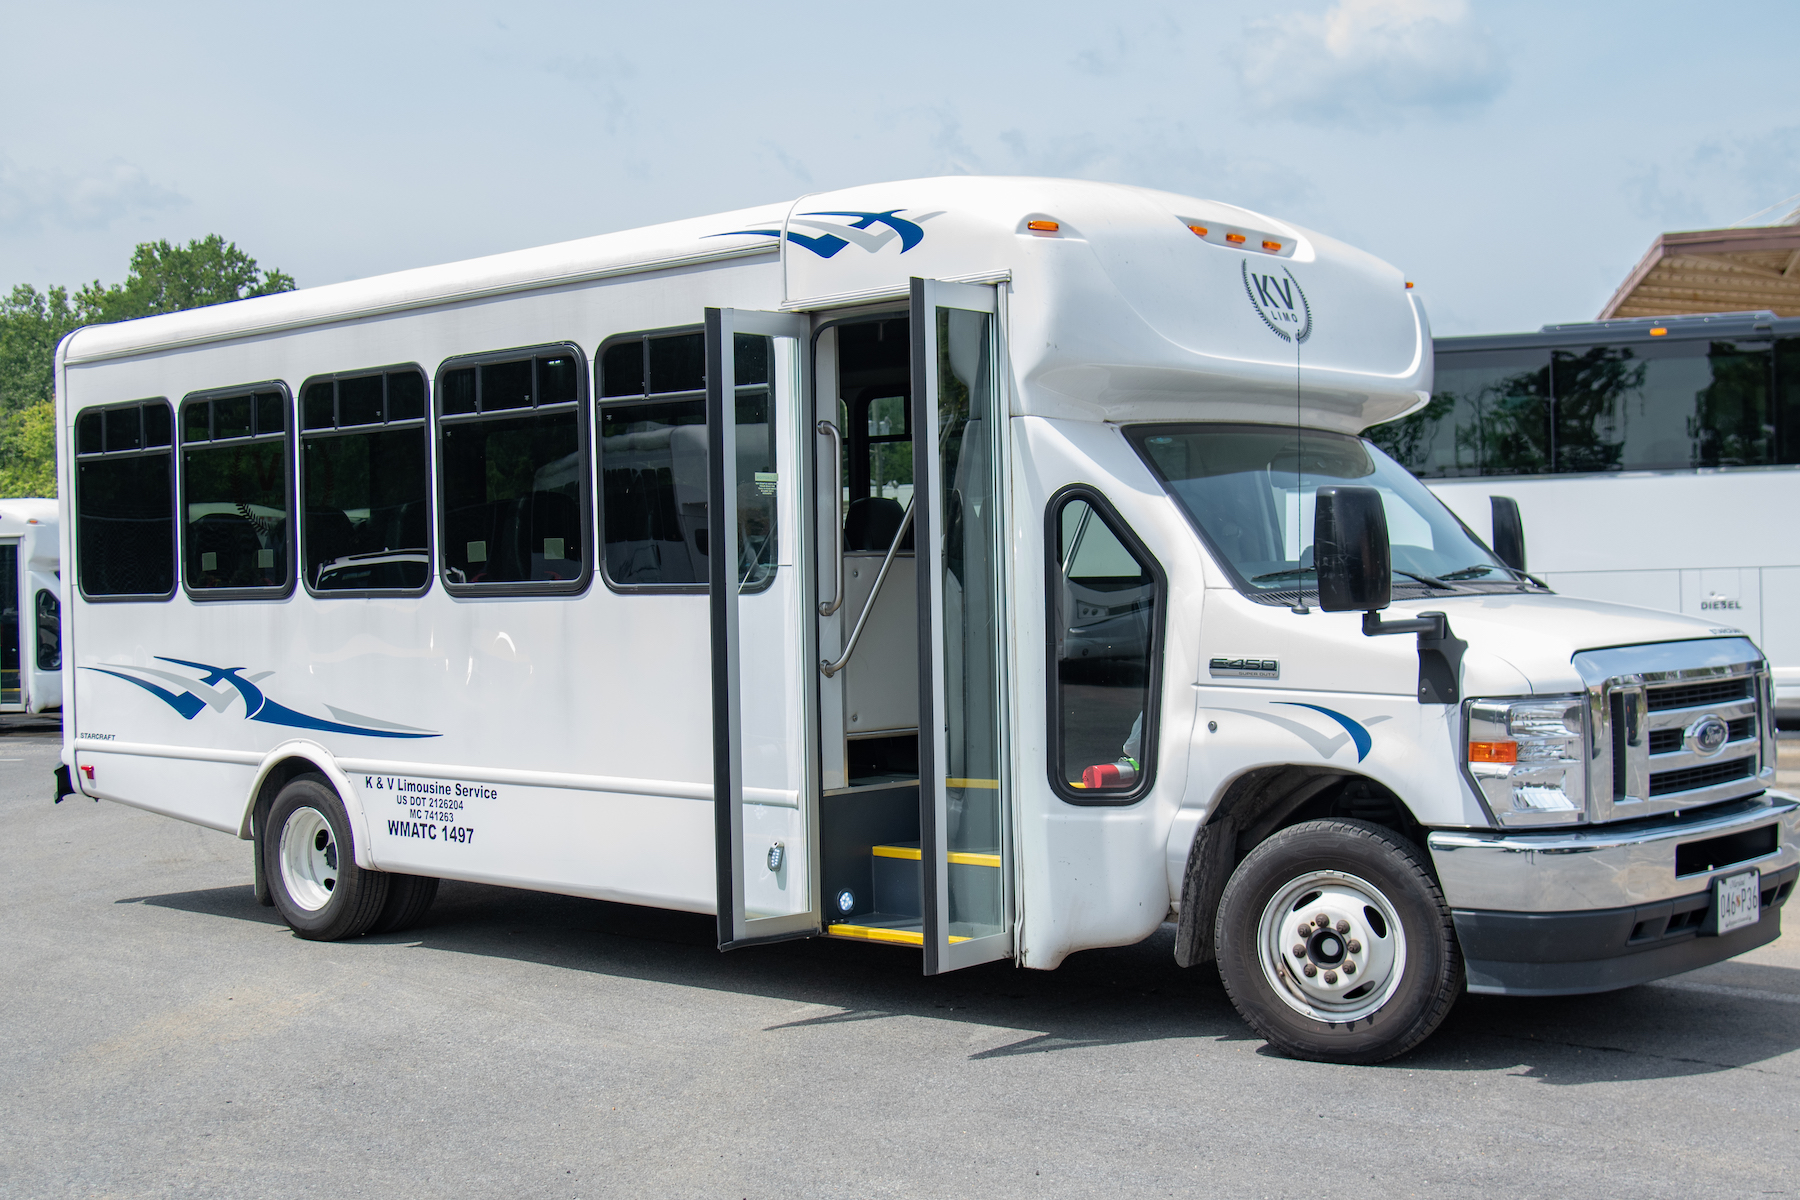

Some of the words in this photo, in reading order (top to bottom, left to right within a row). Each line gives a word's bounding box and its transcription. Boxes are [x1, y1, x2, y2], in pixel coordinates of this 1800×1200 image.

[1251, 272, 1294, 310] KV
[1270, 310, 1298, 323] LIMO
[1701, 601, 1742, 610] DIESEL
[80, 732, 116, 741] STARCRAFT
[365, 776, 373, 789] K
[376, 777, 384, 790] &
[387, 778, 394, 790] V
[398, 779, 451, 796] Limousine
[455, 783, 498, 800] Service
[396, 795, 408, 805] US
[410, 796, 426, 807] DOT
[429, 798, 464, 810] 2126204
[409, 809, 422, 819] MC
[424, 810, 454, 822] 741263
[388, 819, 437, 840] WMATC
[441, 825, 474, 844] 1497
